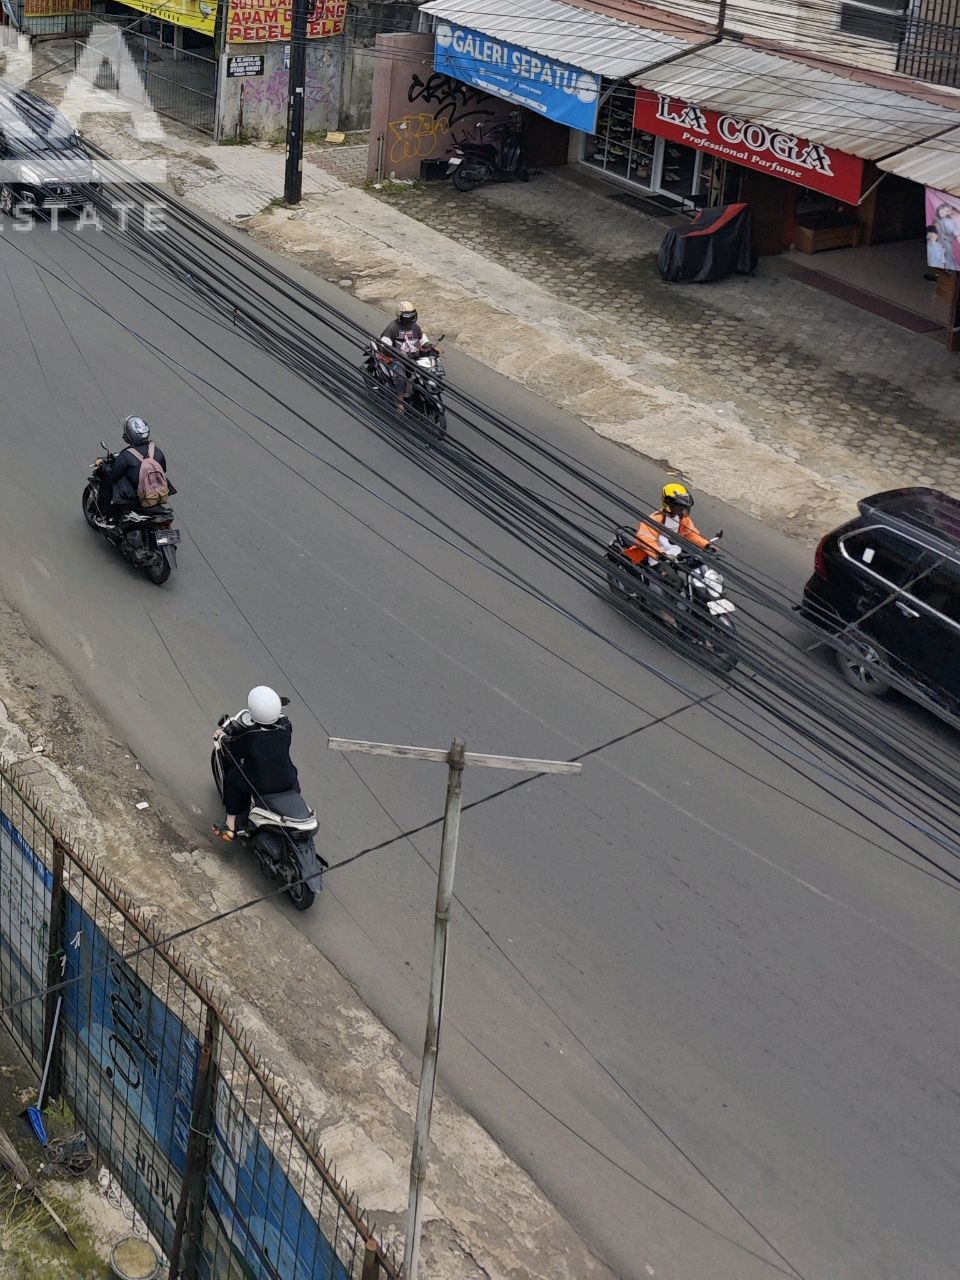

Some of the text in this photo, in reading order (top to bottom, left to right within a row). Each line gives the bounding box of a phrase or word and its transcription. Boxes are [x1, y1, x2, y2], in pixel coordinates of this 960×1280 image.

[228, 24, 292, 40] PECEL
[231, 10, 278, 26] AYAM
[452, 29, 508, 70] GALERI
[511, 50, 577, 95] SEPATU
[656, 94, 834, 177] LA COGA
[681, 131, 803, 178] Professional Parfume
